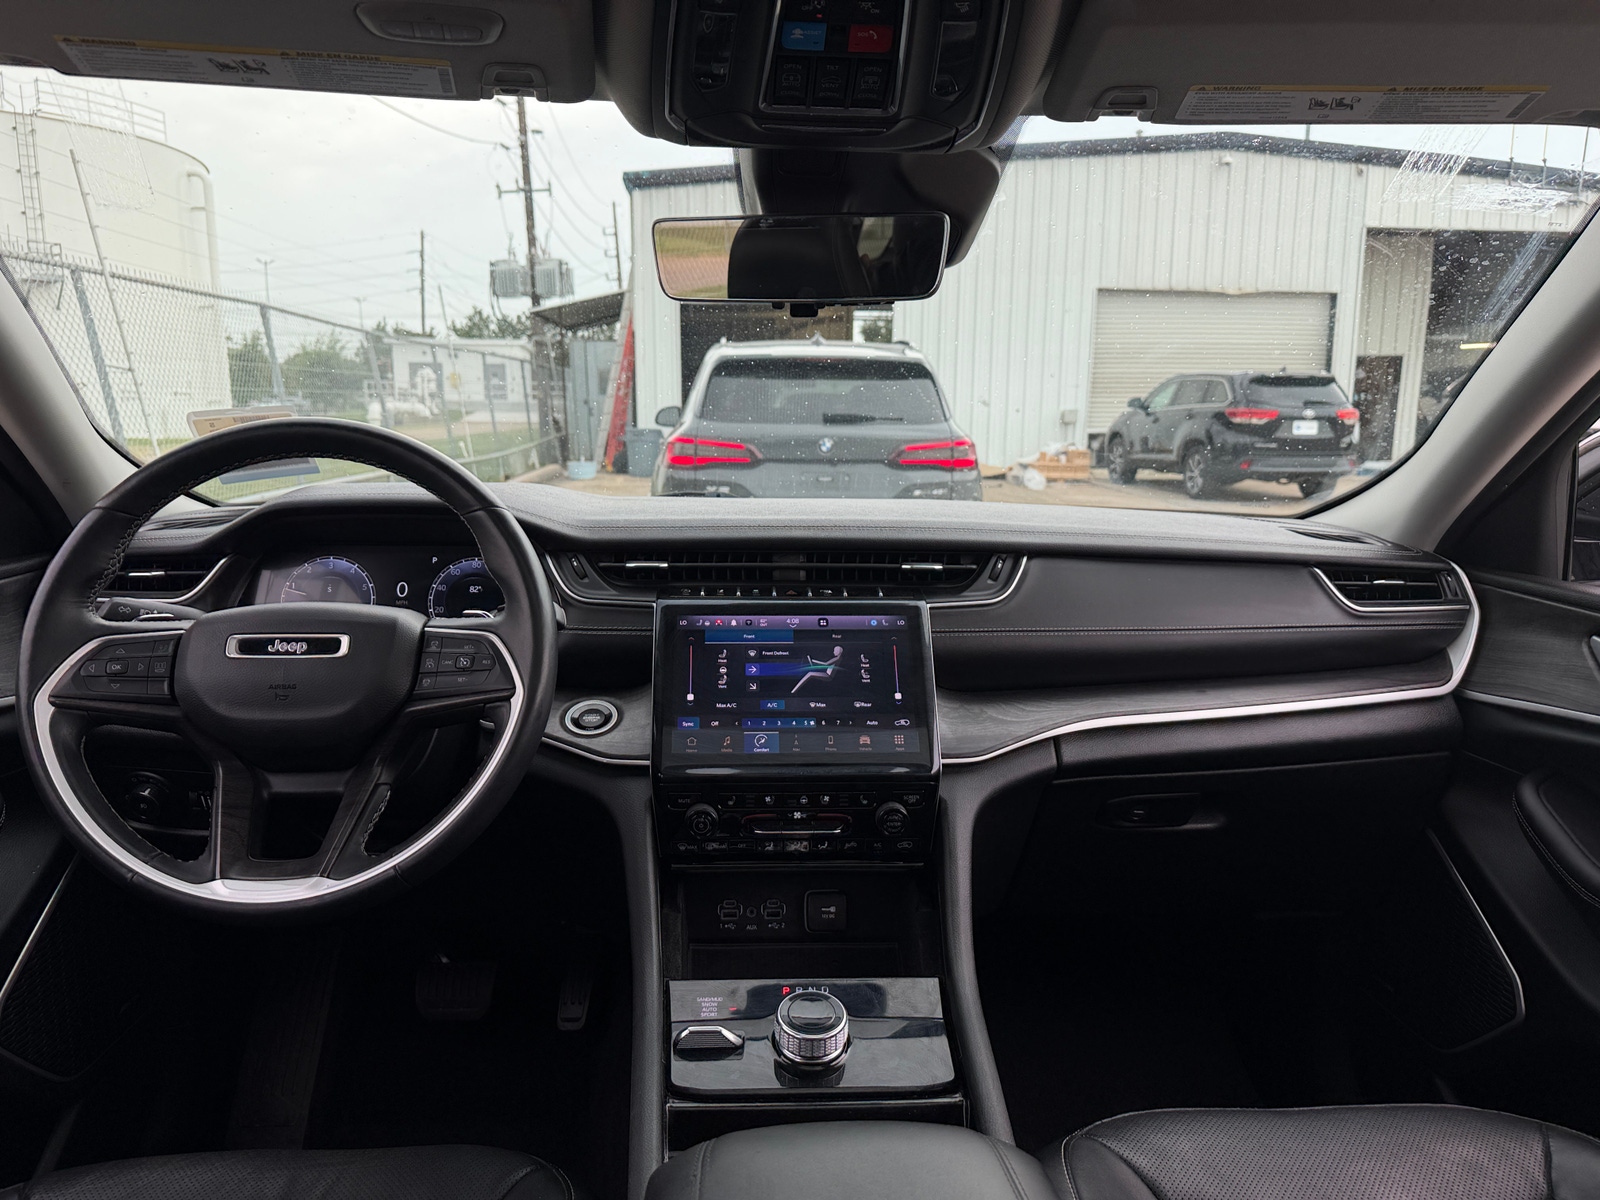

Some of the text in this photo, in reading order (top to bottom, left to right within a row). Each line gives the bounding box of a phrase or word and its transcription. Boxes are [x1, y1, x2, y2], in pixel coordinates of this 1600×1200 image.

[450, 568, 461, 576] 60
[396, 581, 408, 597] 0
[267, 639, 308, 654] Jeep
[782, 986, 790, 995] P
[821, 986, 829, 994] D
